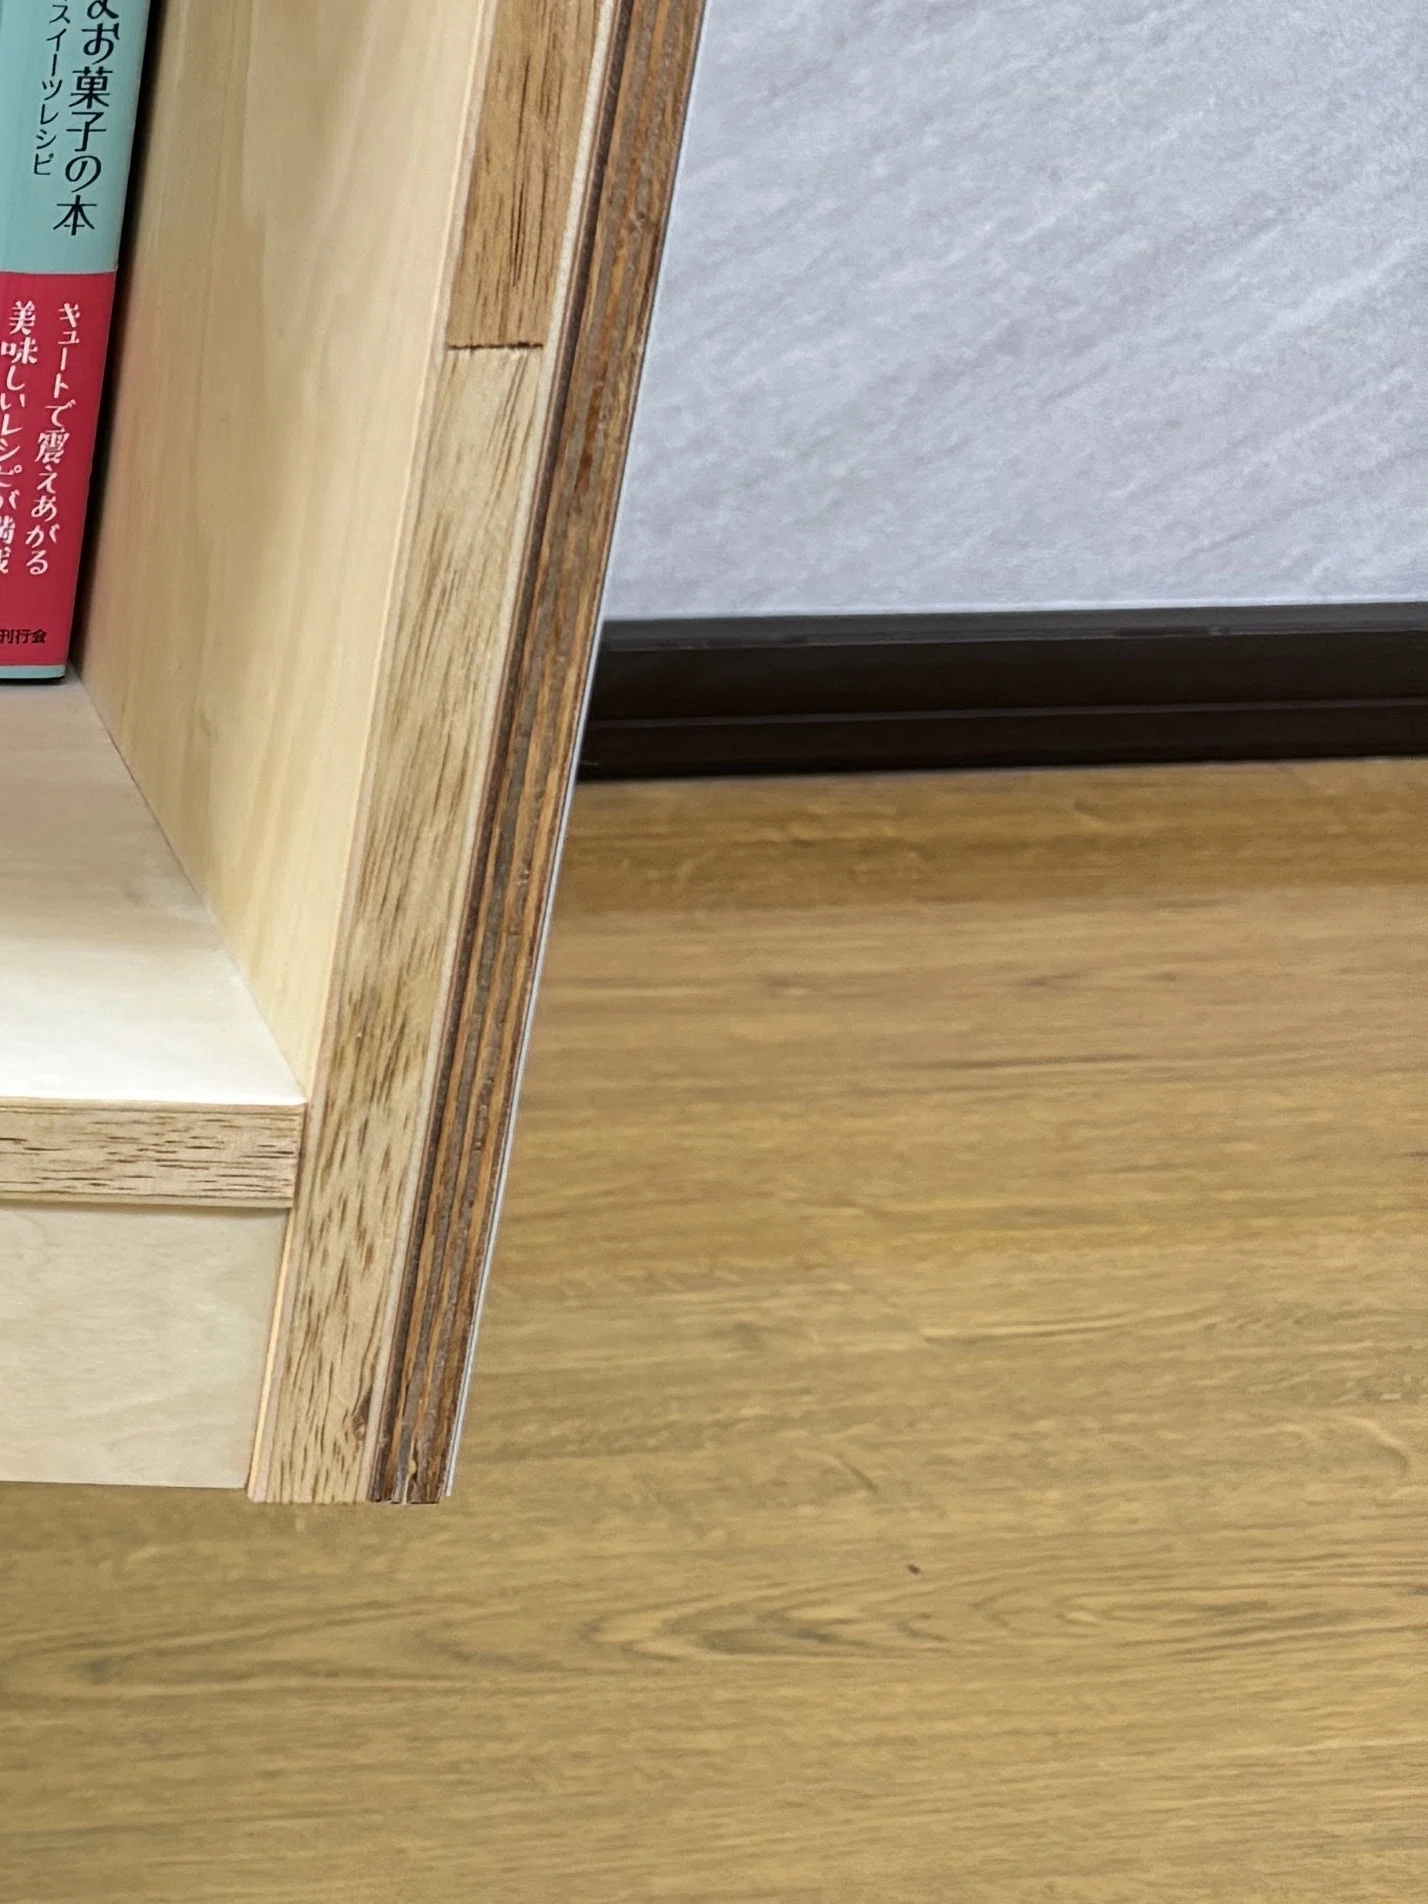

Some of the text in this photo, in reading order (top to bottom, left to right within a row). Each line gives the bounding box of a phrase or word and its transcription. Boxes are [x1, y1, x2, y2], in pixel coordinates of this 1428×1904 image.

[25, 302, 82, 576] キュートで震えあがる
